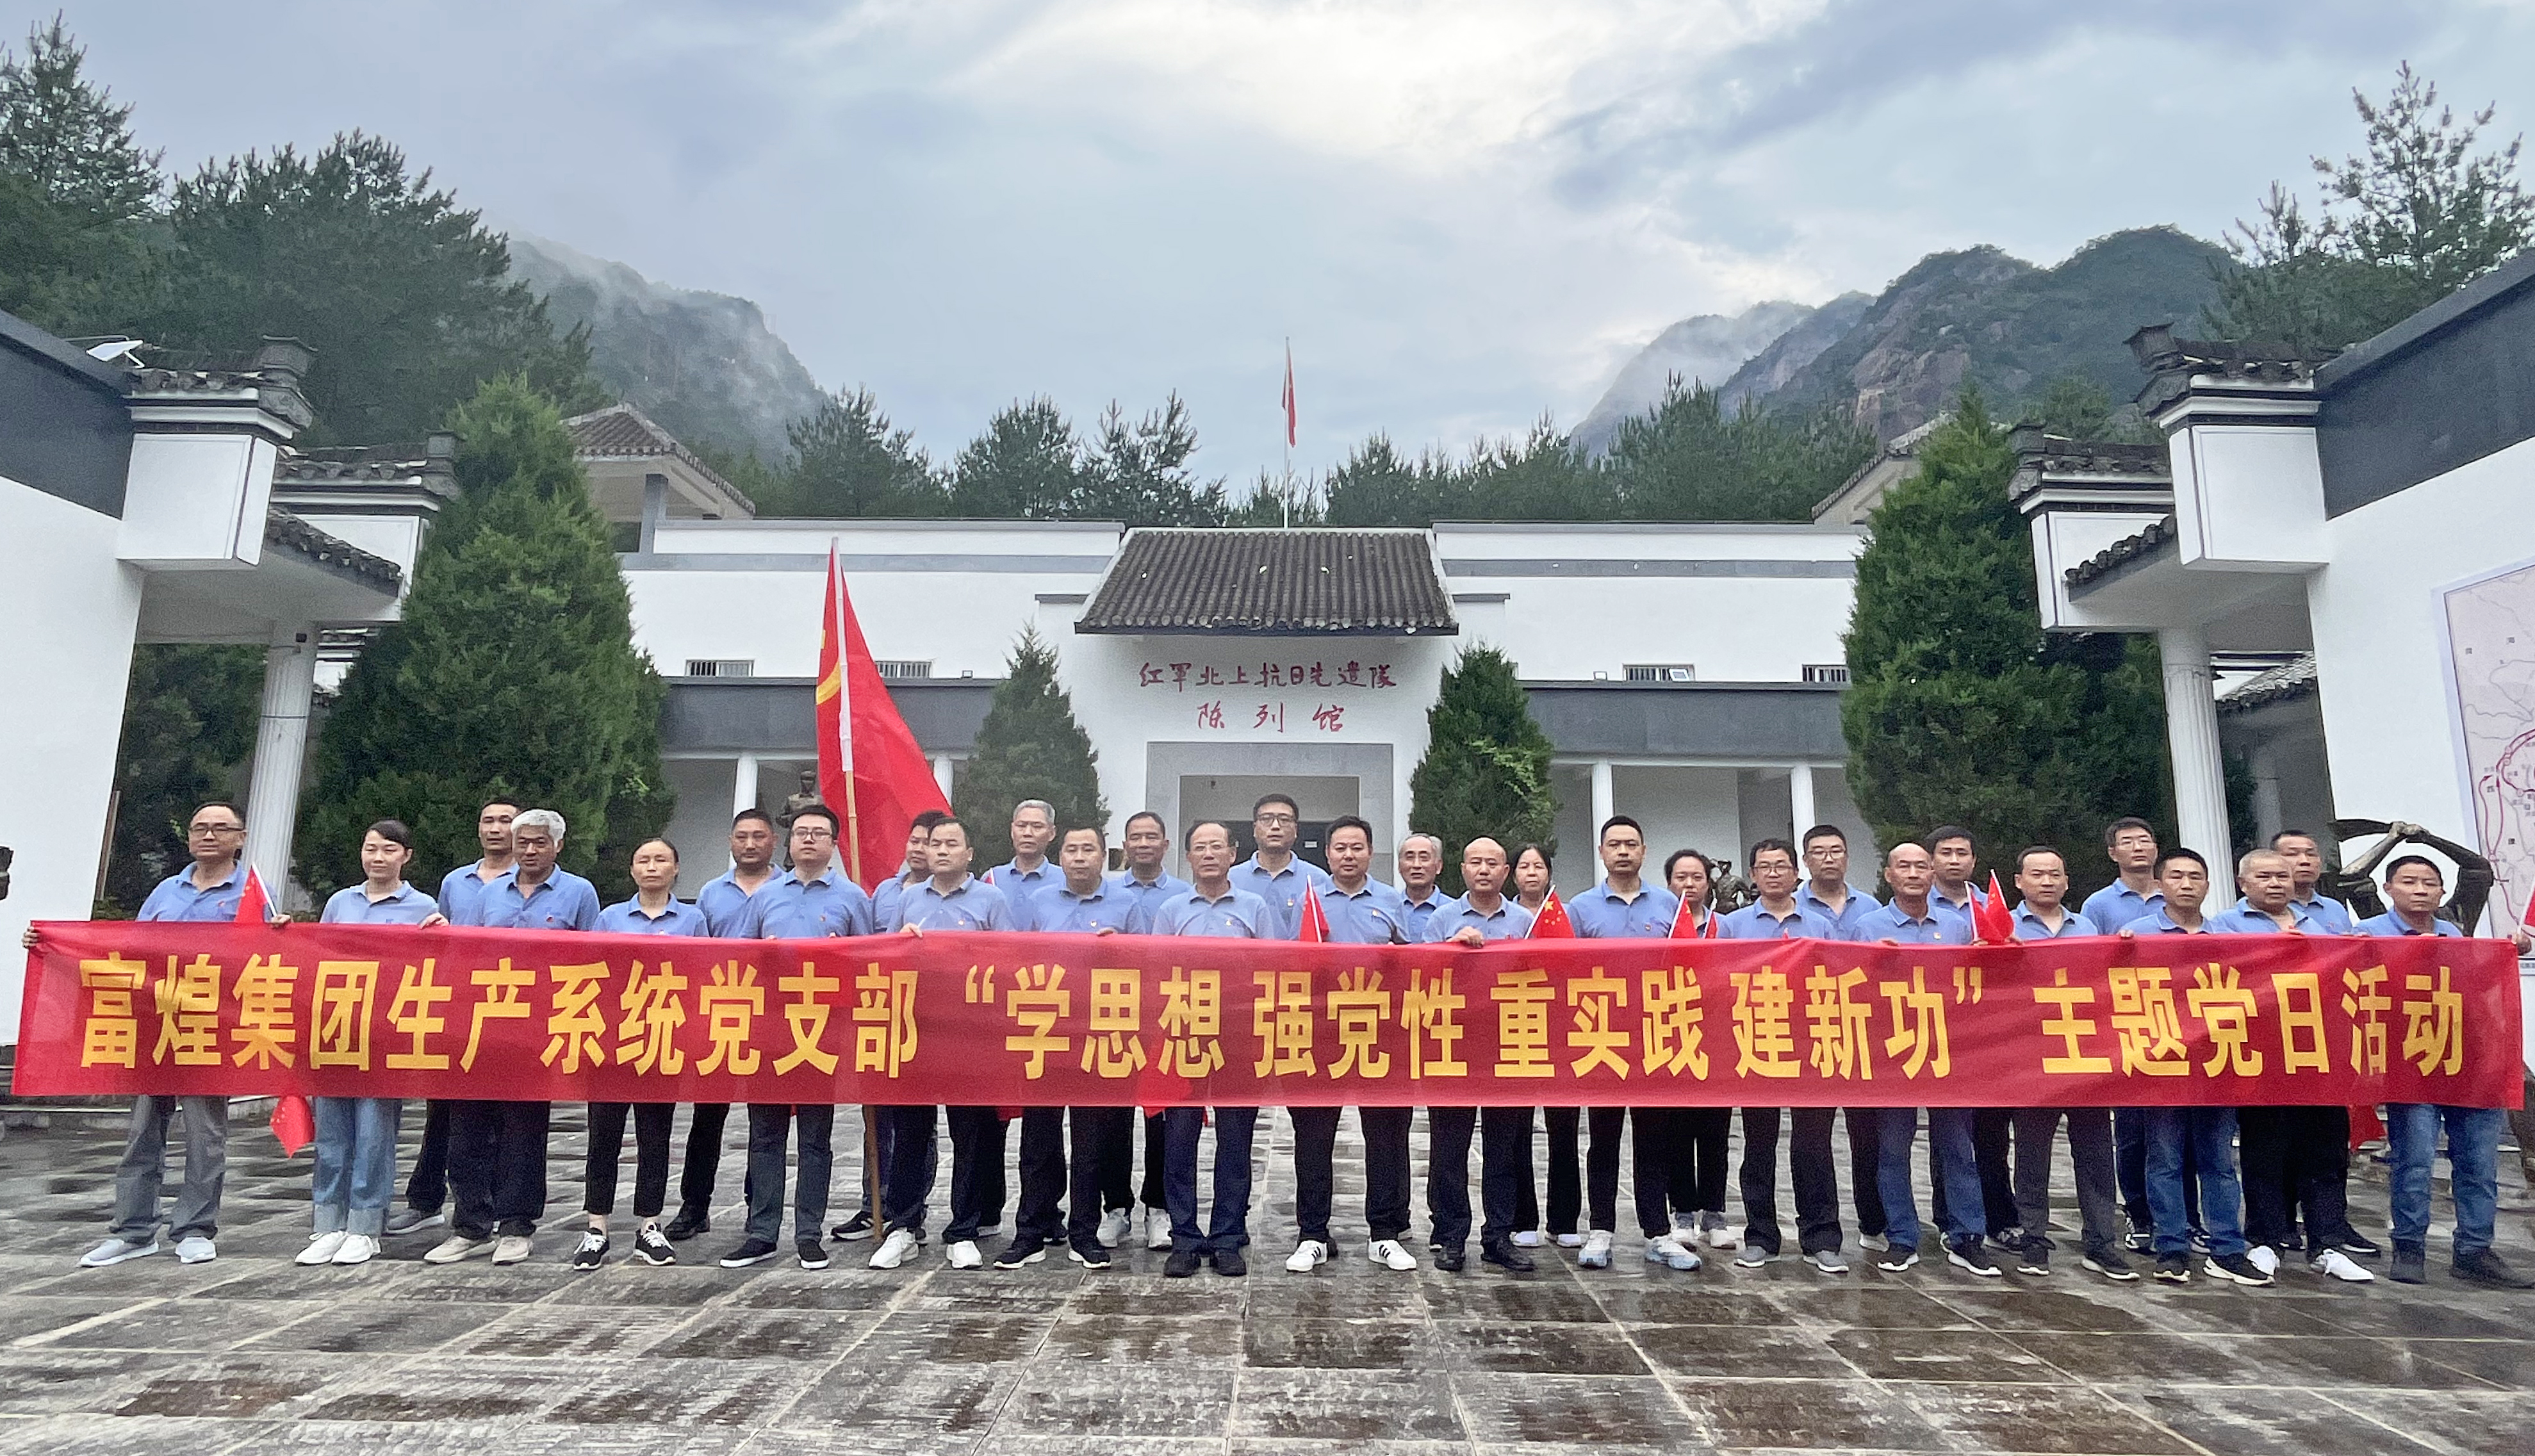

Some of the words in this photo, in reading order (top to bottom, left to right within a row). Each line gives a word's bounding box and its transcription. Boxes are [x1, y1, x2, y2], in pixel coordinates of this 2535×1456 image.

[79, 951, 919, 1078] 富煌集团生产系统党支部
[2033, 962, 2463, 1077] 主题党日活动
